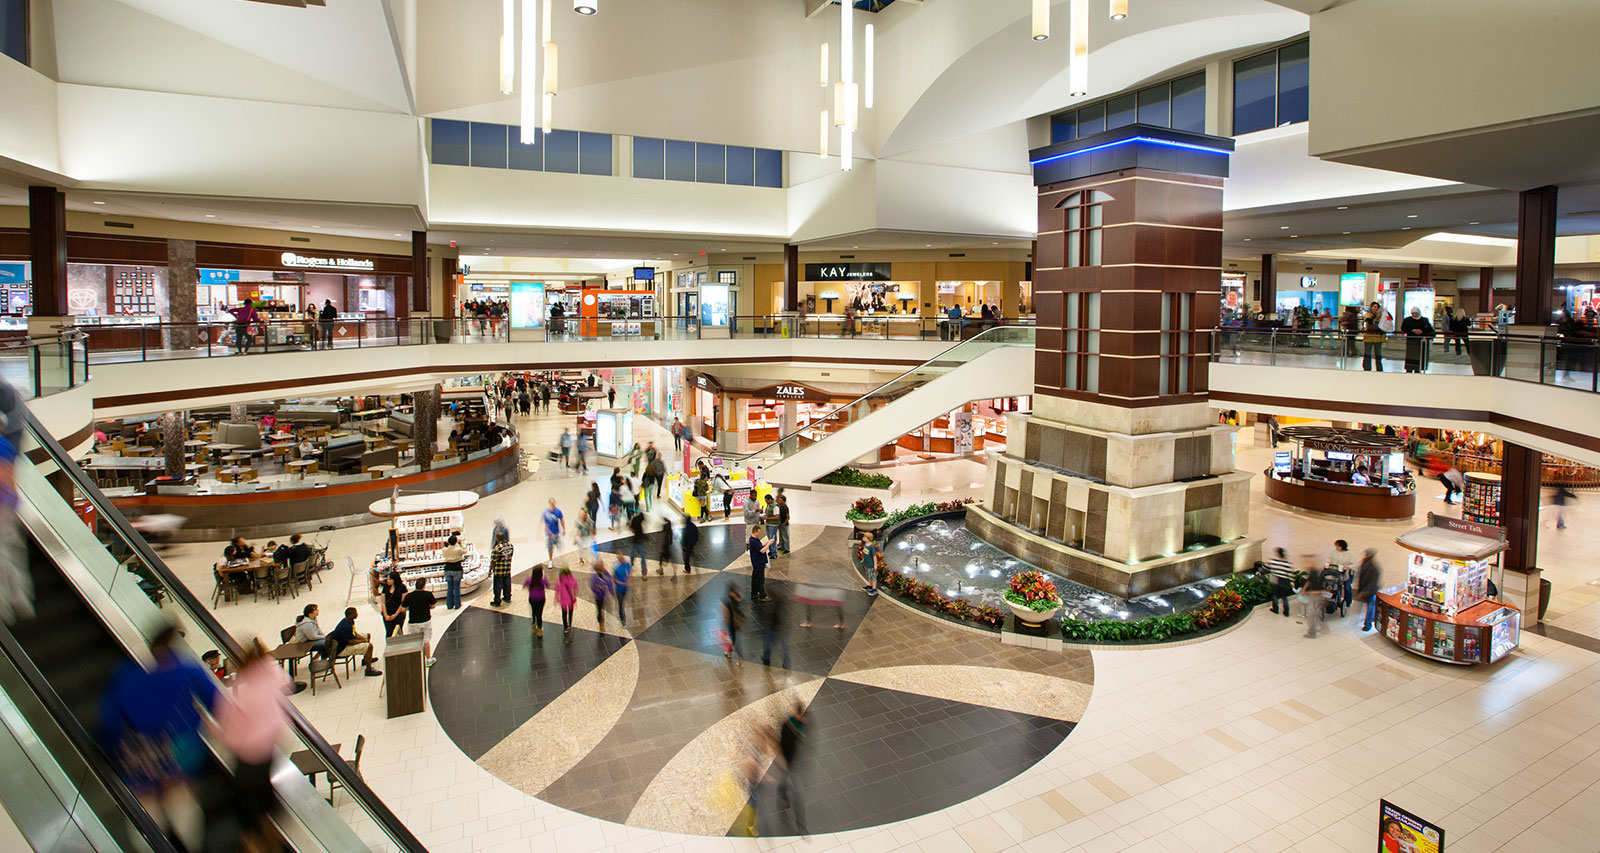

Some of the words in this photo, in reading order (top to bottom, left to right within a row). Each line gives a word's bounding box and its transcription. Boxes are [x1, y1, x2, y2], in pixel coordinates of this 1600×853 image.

[296, 256, 328, 267] Rogers
[329, 258, 336, 266] &
[337, 258, 374, 267] Hollands
[821, 267, 846, 277] KAY
[776, 386, 805, 395] ZALES
[1313, 441, 1341, 452] SIMON
[1448, 520, 1467, 530] Street
[1468, 524, 1483, 533] Talk
